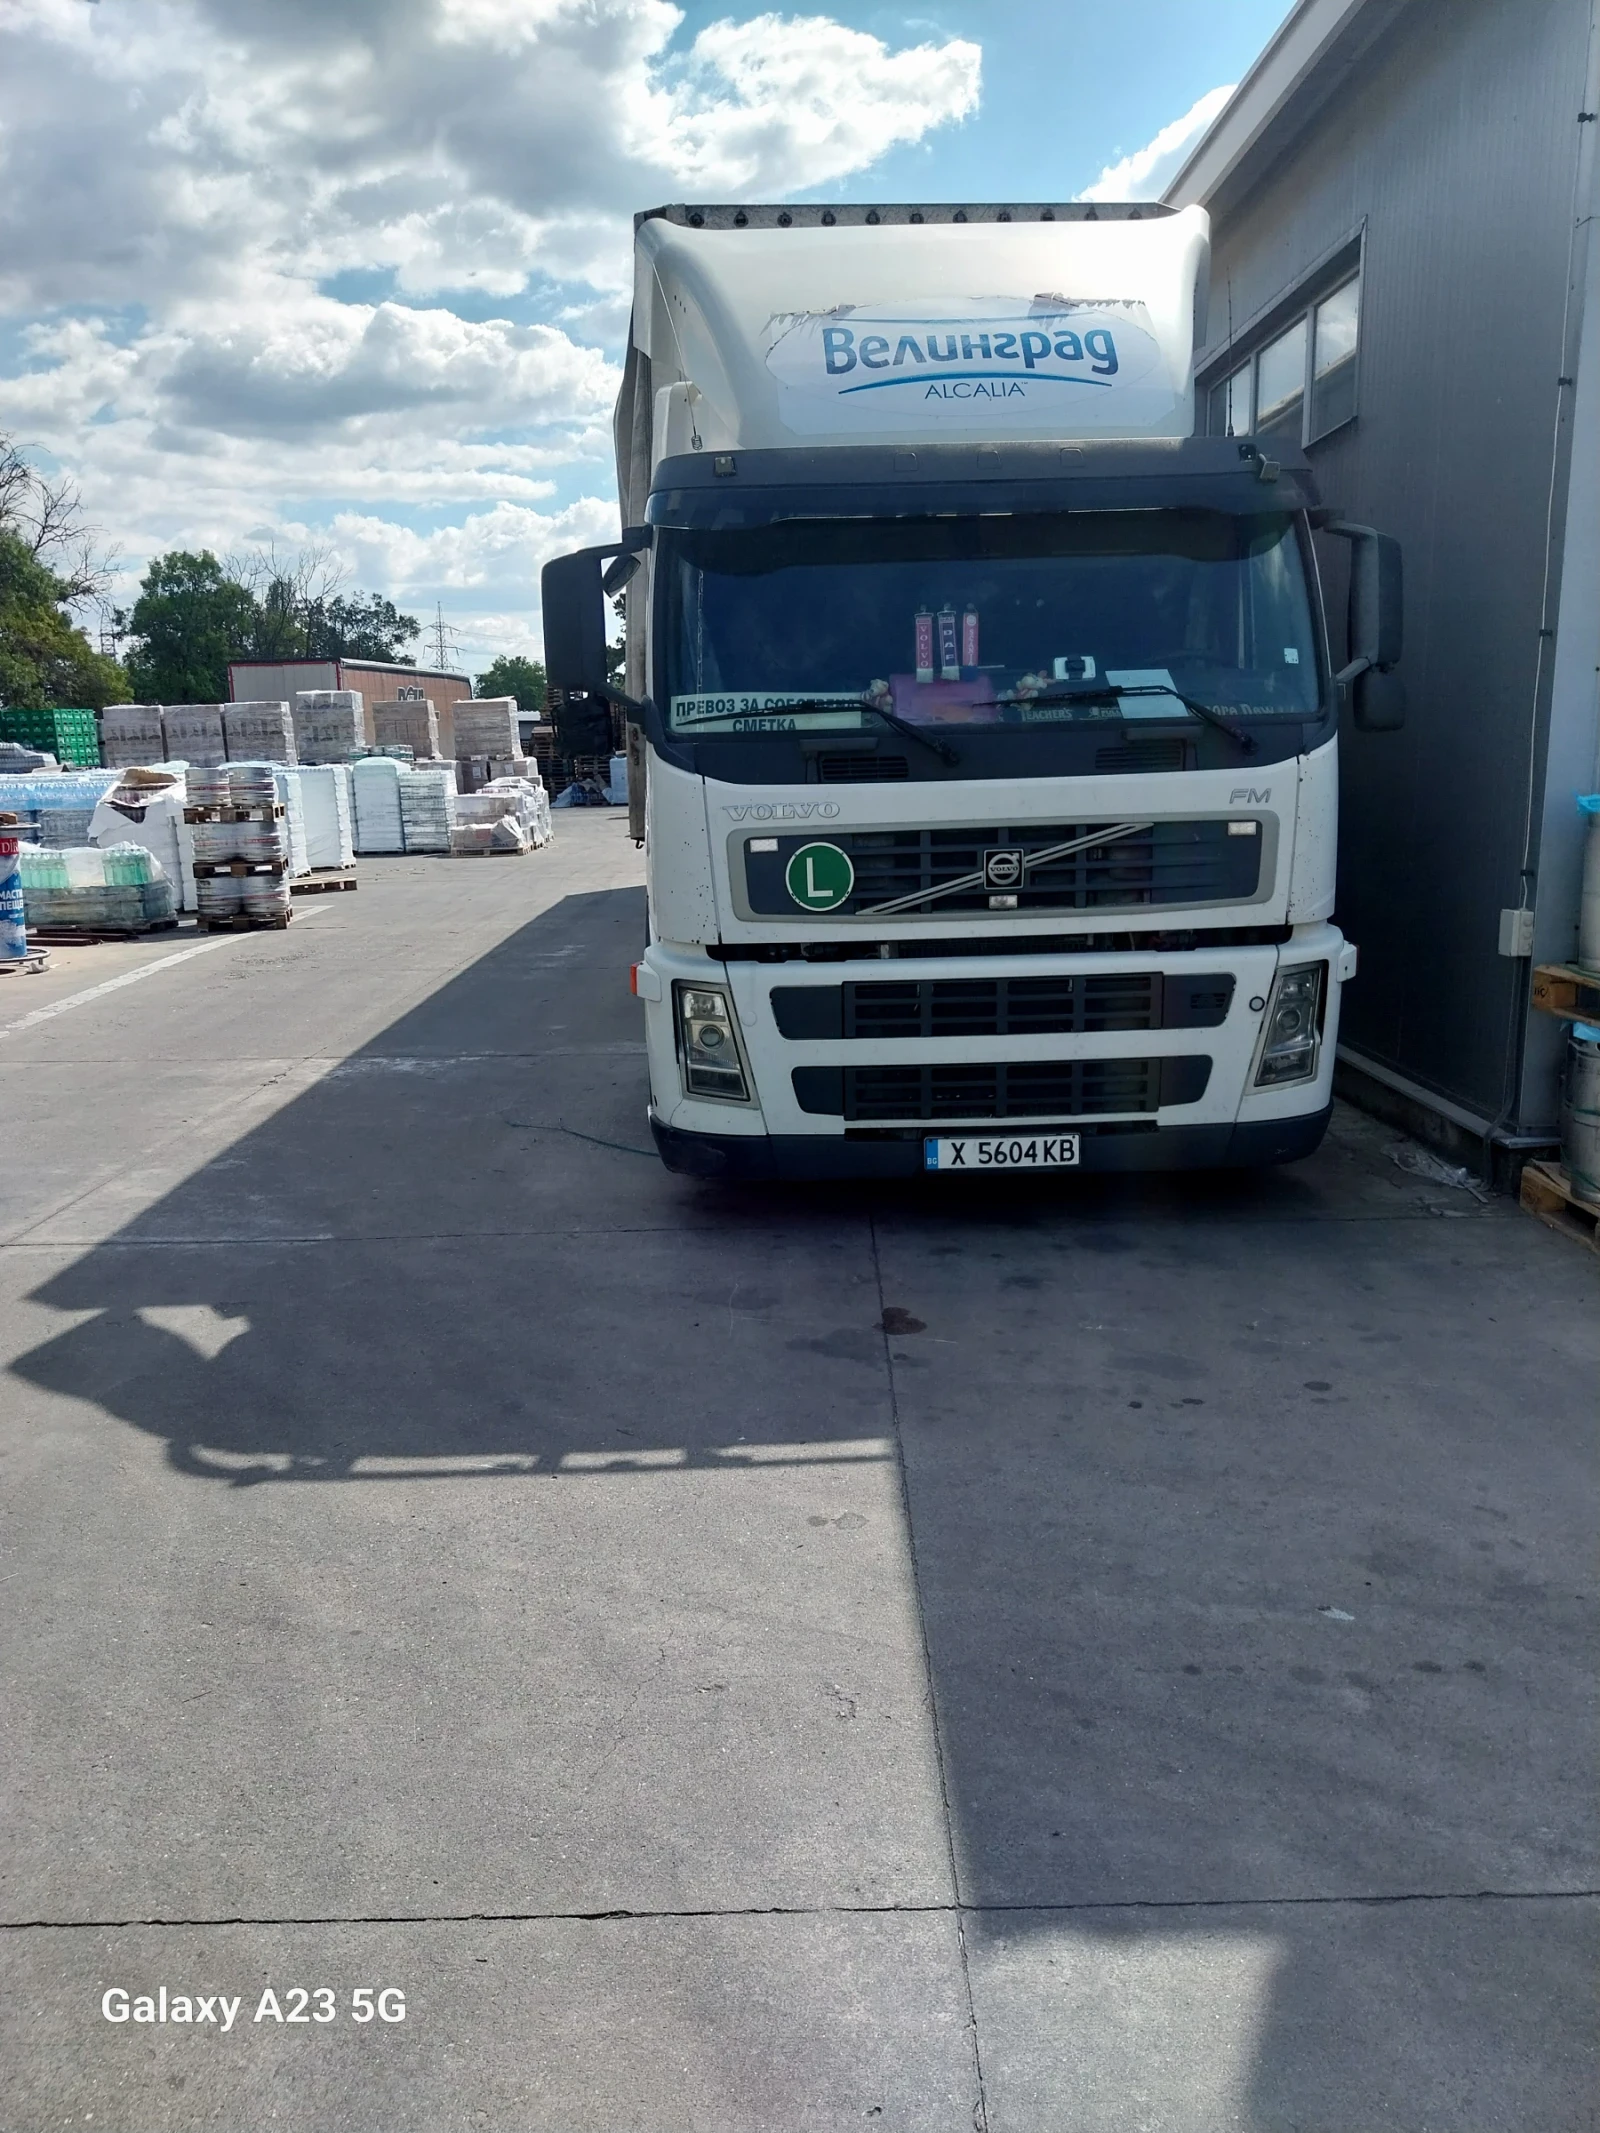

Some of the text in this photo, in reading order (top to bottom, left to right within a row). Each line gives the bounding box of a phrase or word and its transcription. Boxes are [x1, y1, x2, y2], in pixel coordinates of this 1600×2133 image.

[822, 327, 1119, 375] Велинград
[920, 626, 928, 667] VOLVO
[943, 630, 955, 660] DAF
[676, 699, 735, 716] ПРЕВОЗ
[740, 698, 759, 712] ЗА
[733, 719, 797, 732] СМЕТКА
[1229, 788, 1272, 804] FM
[723, 802, 840, 821] VOLVO
[807, 857, 834, 899] L
[927, 1157, 938, 1165] BG
[951, 1139, 1075, 1165] X 5604 KB
